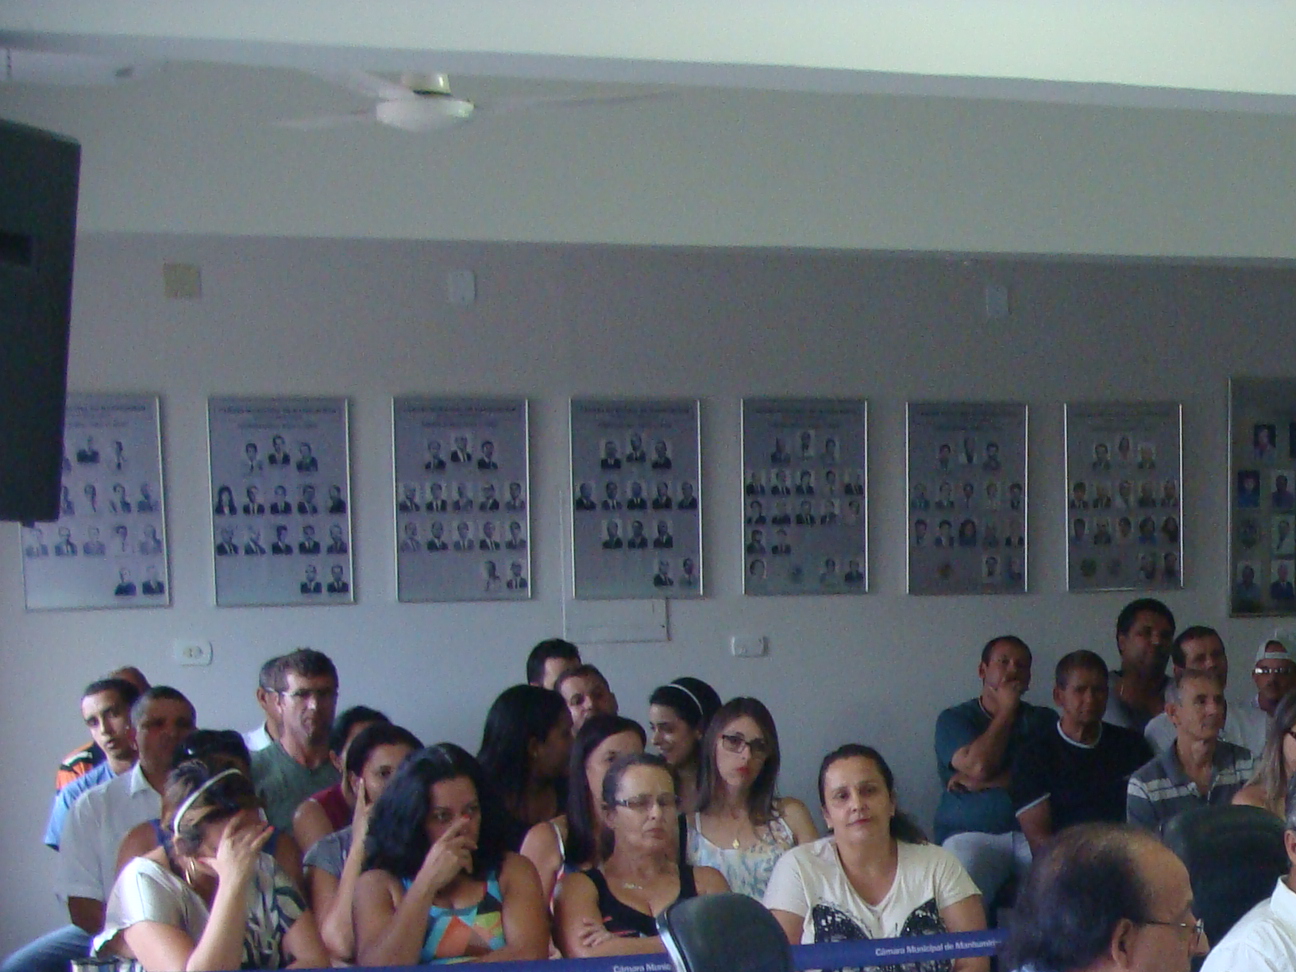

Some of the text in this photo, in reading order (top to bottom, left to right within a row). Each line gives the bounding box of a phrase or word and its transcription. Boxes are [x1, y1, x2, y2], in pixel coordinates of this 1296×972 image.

[875, 948, 906, 957] Câmara
[906, 942, 944, 954] Municipal
[945, 943, 954, 951] de
